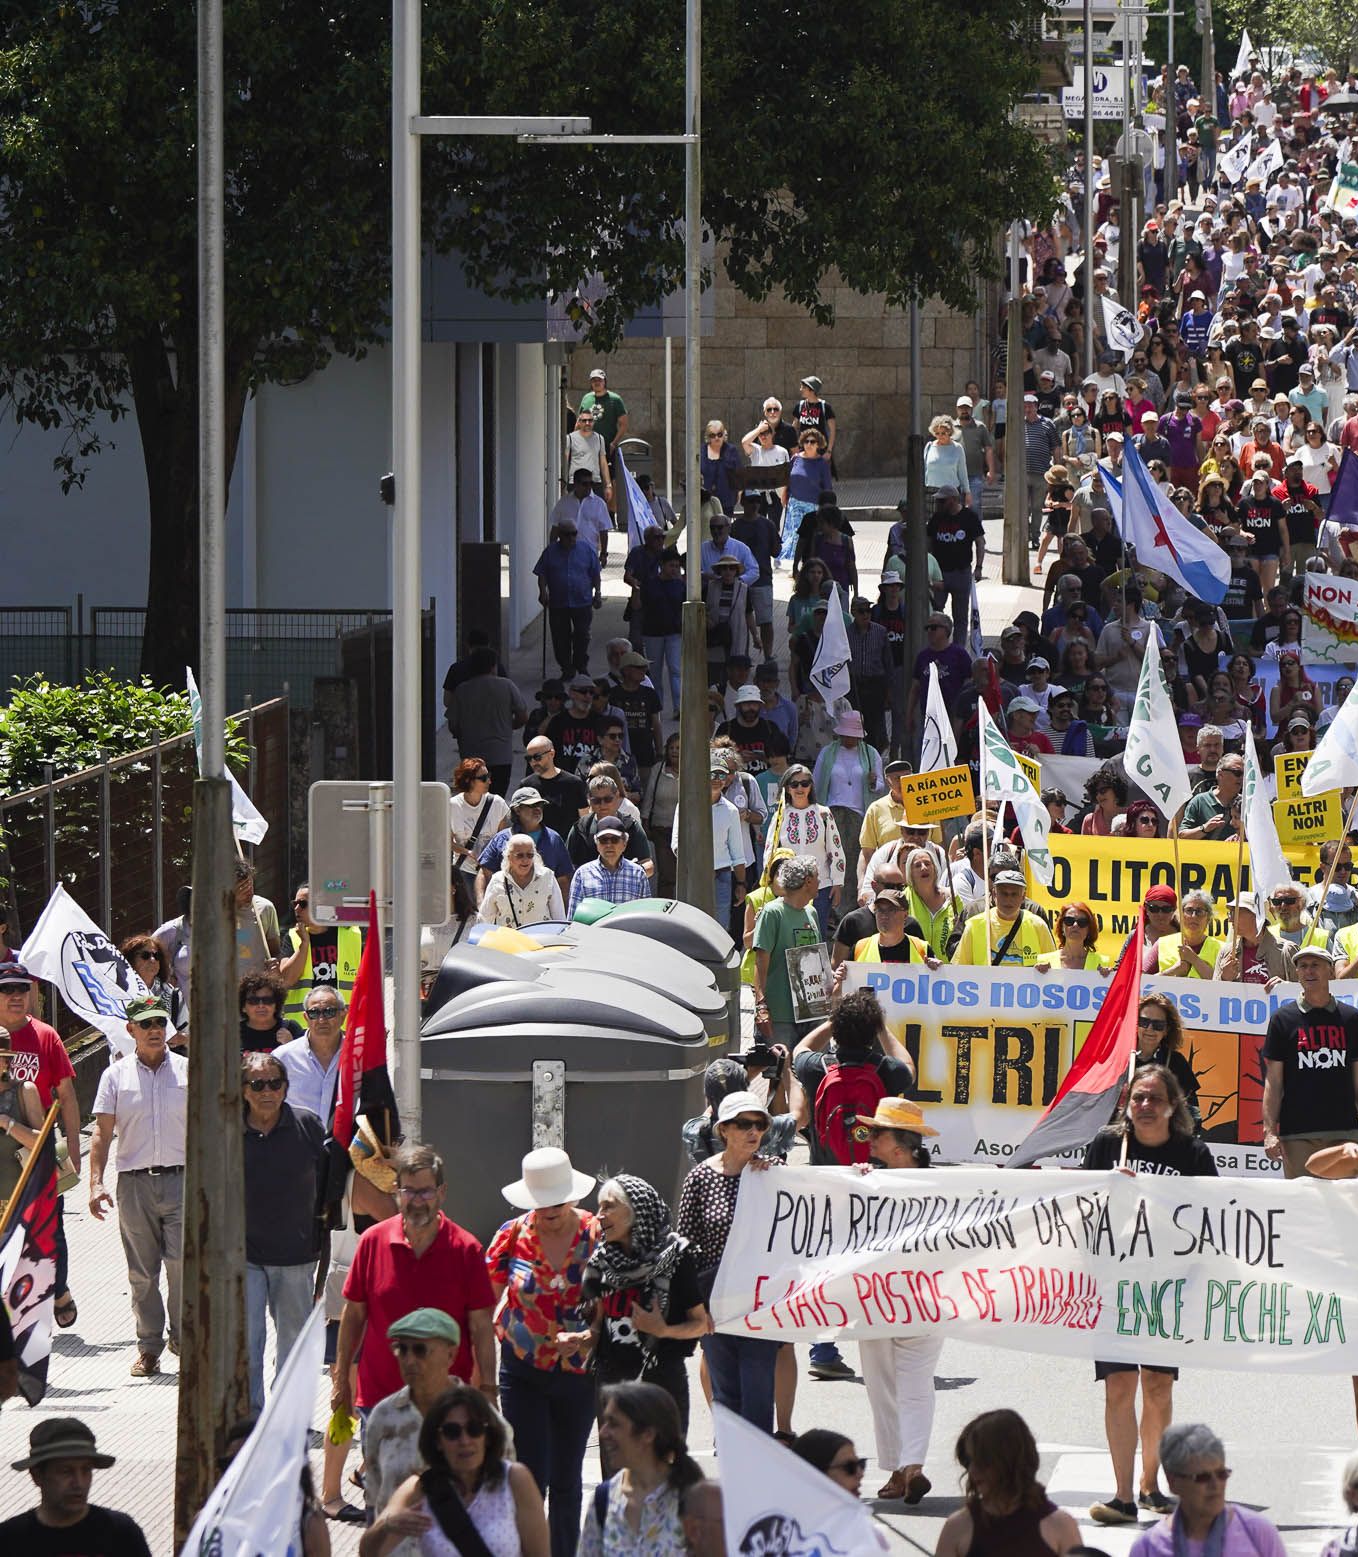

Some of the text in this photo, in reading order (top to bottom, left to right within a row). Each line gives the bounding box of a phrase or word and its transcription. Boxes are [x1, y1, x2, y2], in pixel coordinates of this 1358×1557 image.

[1065, 95, 1113, 103] MEGADRA,
[1246, 518, 1271, 528] NON
[1308, 585, 1351, 605] NON
[906, 773, 967, 793] A RÍA NON
[916, 788, 963, 806] SE TOCA
[1287, 800, 1327, 816] ALTRI
[1293, 815, 1324, 830] NON
[867, 971, 979, 1007] Polos
[1298, 1025, 1345, 1051] ALTRI
[903, 1023, 1062, 1107] LTRI
[1298, 1047, 1346, 1070] NON
[767, 1189, 833, 1258] POLA
[1033, 1197, 1078, 1250] DA
[1173, 1199, 1285, 1268] SAÚDE
[744, 1275, 769, 1331] E
[852, 1270, 959, 1325] POSTOS
[963, 1267, 1002, 1323] DE
[1203, 1279, 1295, 1346] PECHE
[1303, 1290, 1346, 1345] XA
